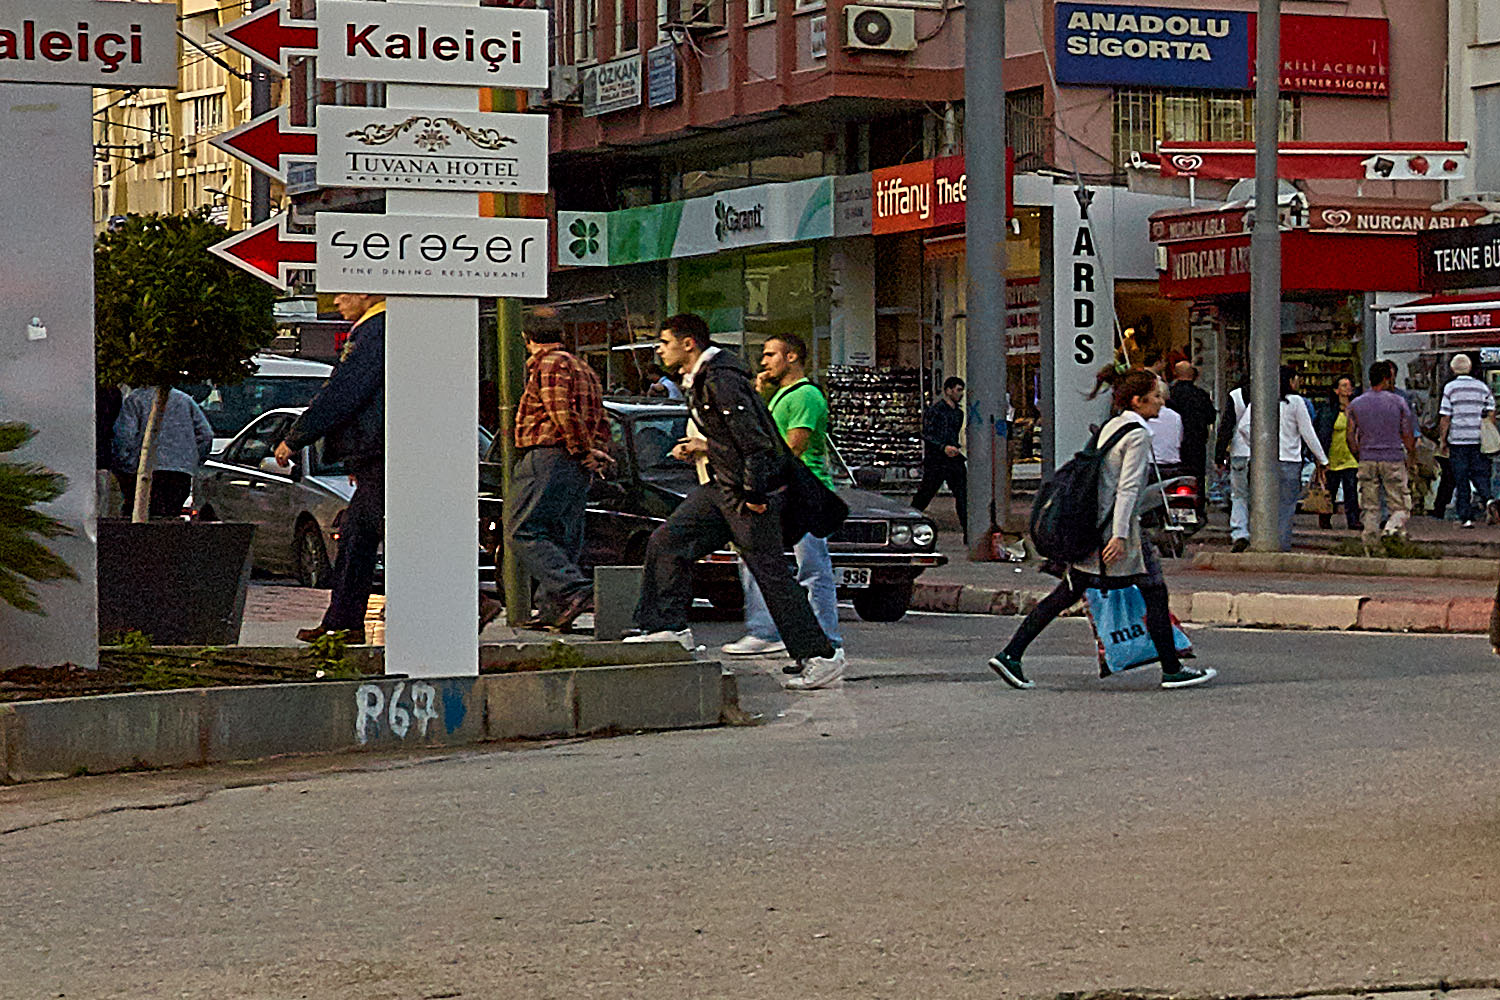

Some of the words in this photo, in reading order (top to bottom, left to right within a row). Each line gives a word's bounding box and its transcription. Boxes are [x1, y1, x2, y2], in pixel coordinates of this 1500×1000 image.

[1068, 11, 1229, 37] ANADOLU
[0, 20, 142, 73] aleiçi
[346, 23, 521, 73] Kaleiçi
[1067, 32, 1211, 61] SİGORTA
[1323, 62, 1386, 76] ACENTE
[346, 152, 439, 174] TUVANA
[447, 160, 519, 177] HOTEL
[877, 178, 930, 219] tiffany
[1356, 214, 1424, 230] NURCAN
[342, 267, 373, 275] FINE
[382, 268, 433, 276] DINING
[442, 269, 527, 278] RESTAURANT
[1171, 248, 1226, 280] NURCAN
[1434, 247, 1480, 272] TEKNE
[1072, 190, 1095, 365] YARDS
[843, 569, 868, 584] 936
